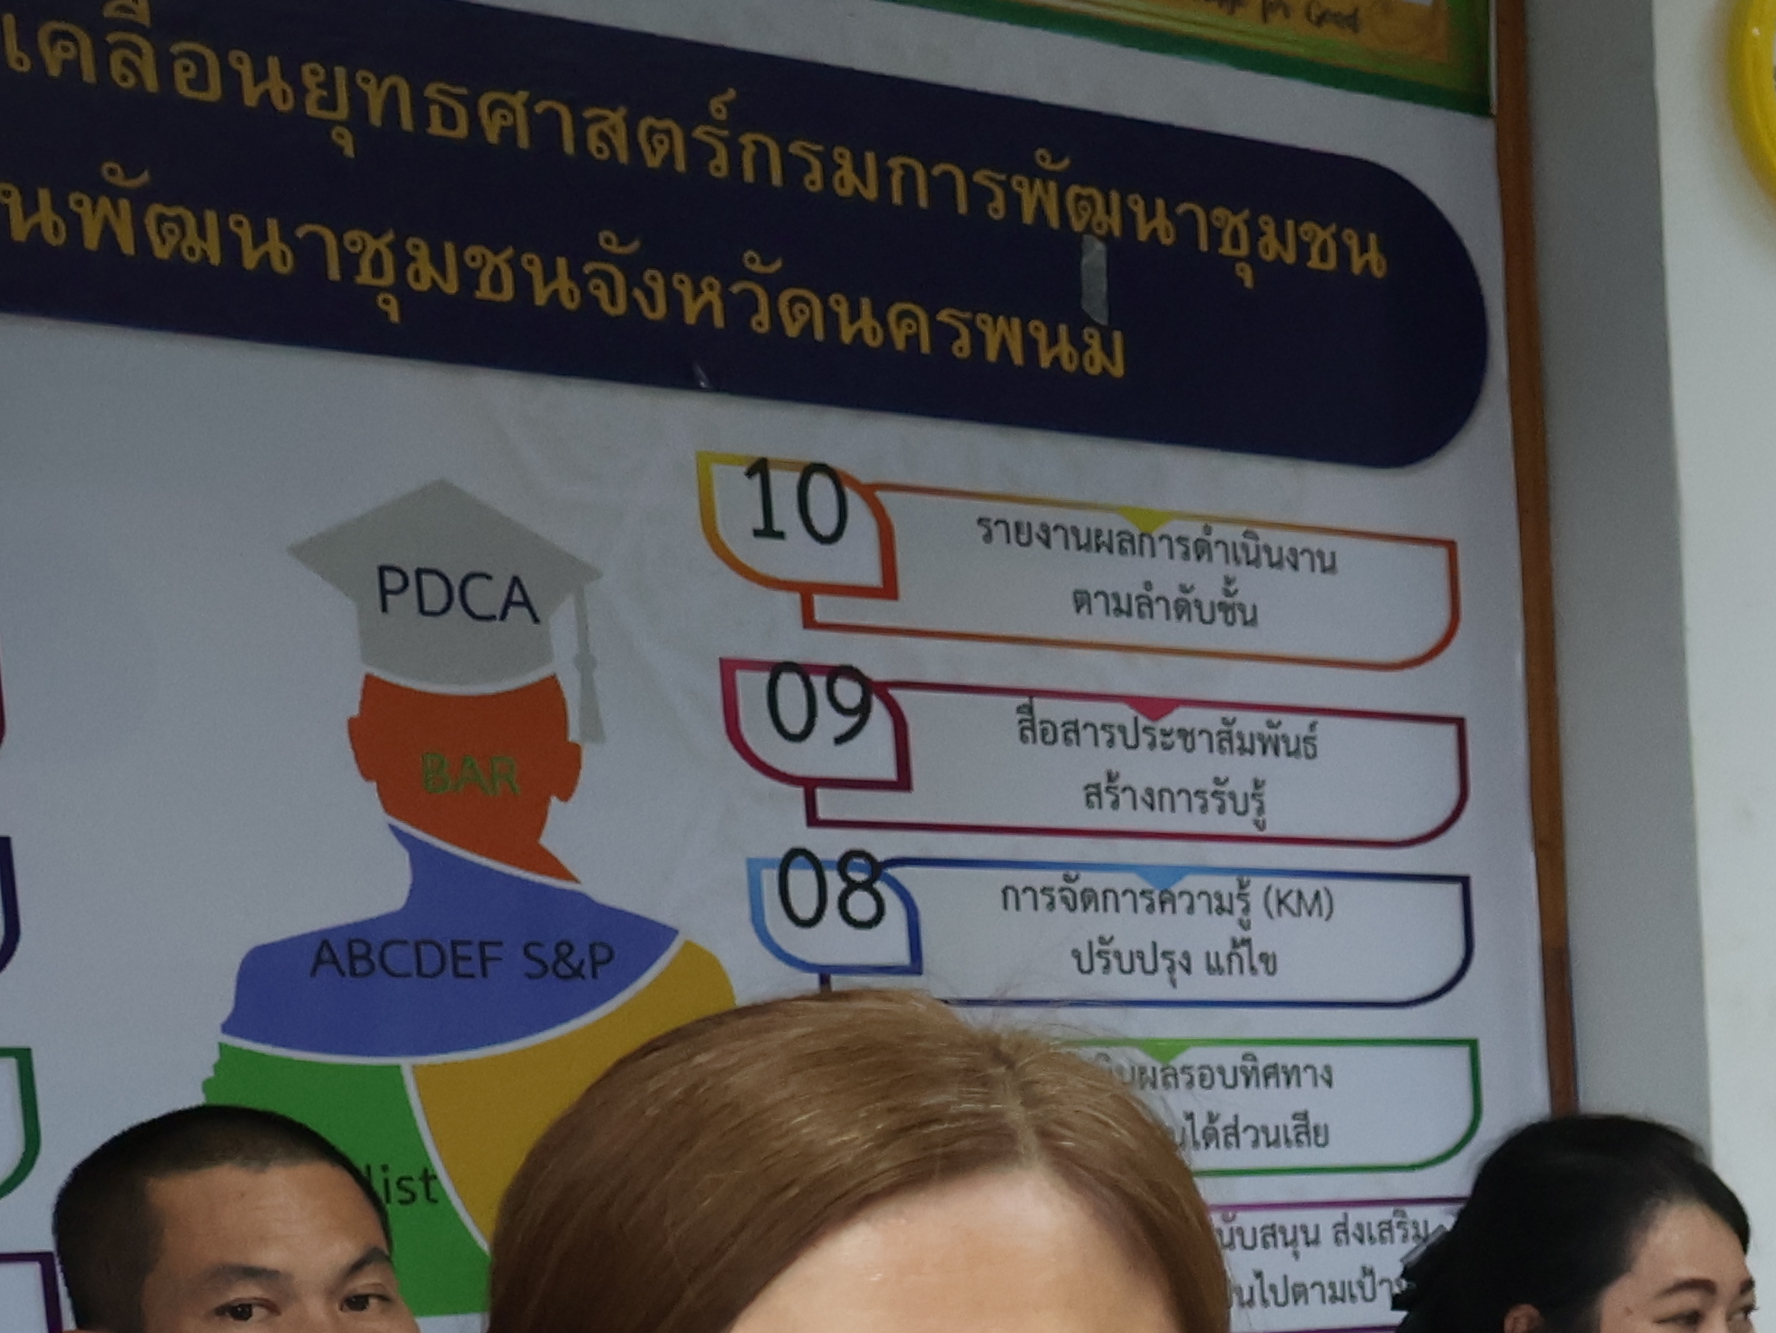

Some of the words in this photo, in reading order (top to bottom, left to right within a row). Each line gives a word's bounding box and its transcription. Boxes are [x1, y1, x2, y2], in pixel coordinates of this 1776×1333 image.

[2, 0, 1387, 289] เคลือนยุทธศาสตร์กรมการพัฒนาชุมชน
[743, 456, 849, 546] 10
[976, 515, 1338, 576] รายงานผลการดำเนินงาน
[376, 564, 541, 625] PDCA
[1072, 574, 1259, 628] ตามลำดับชั้น
[765, 660, 875, 747] 09
[1016, 696, 1320, 761] สื่อสารประชาสัมพันธ์
[420, 751, 521, 797] BAR
[776, 846, 888, 930] 08
[1263, 882, 1335, 923] (KM)
[309, 938, 504, 980] ABCDEF
[523, 939, 616, 981] S&P
